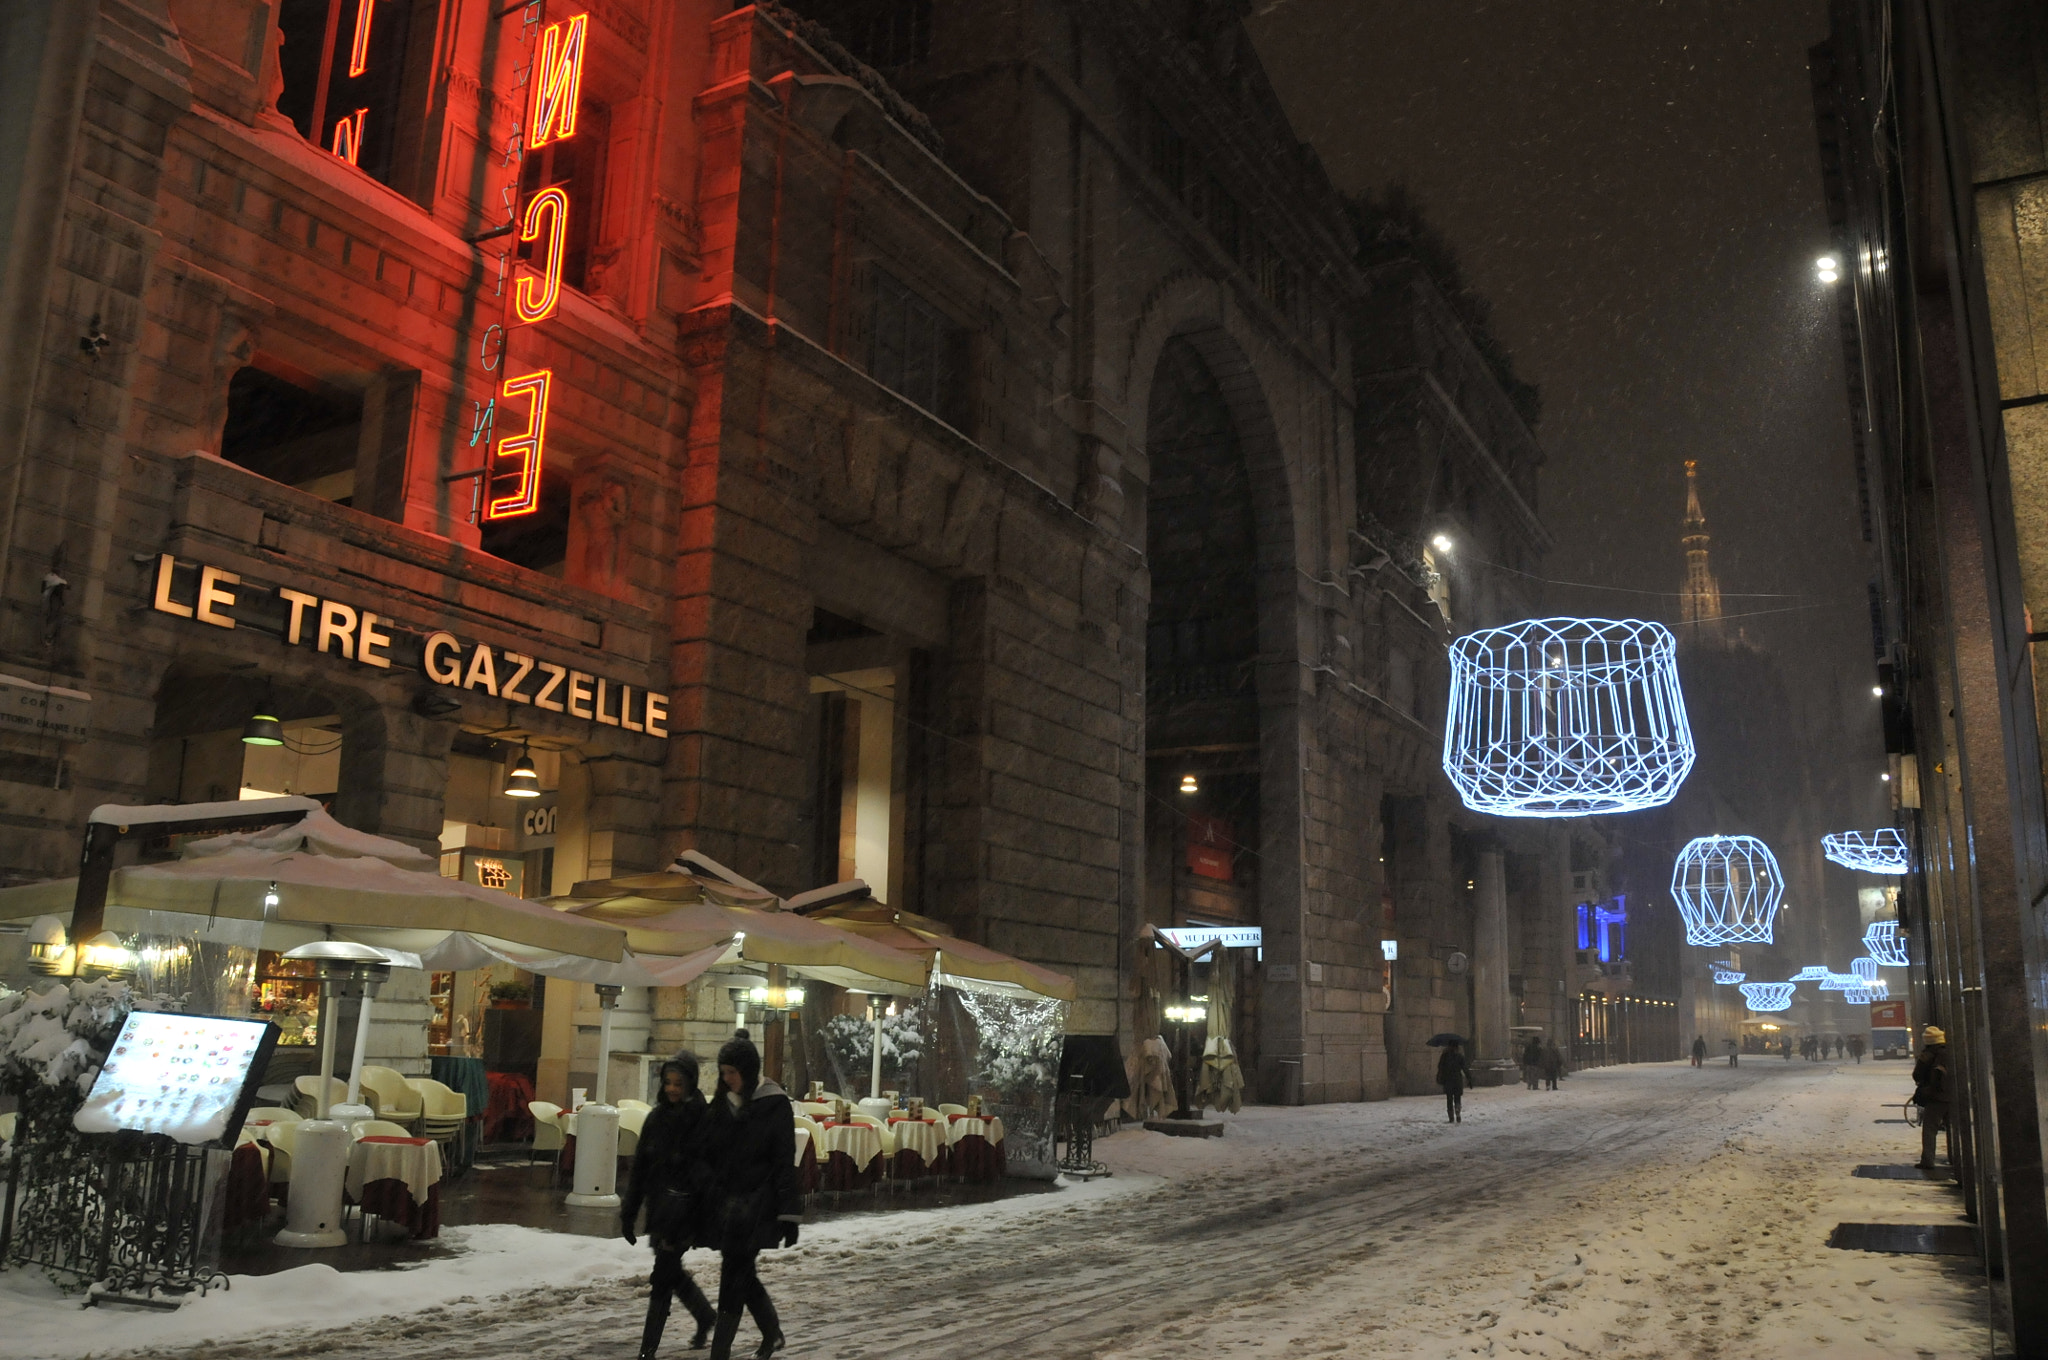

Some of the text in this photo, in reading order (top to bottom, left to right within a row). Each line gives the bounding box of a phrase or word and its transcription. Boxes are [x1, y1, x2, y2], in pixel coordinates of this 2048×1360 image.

[154, 553, 669, 739] LE TRE GAZZELLE
[20, 696, 65, 712] CORO
[1184, 932, 1260, 943] MULTICENTER
